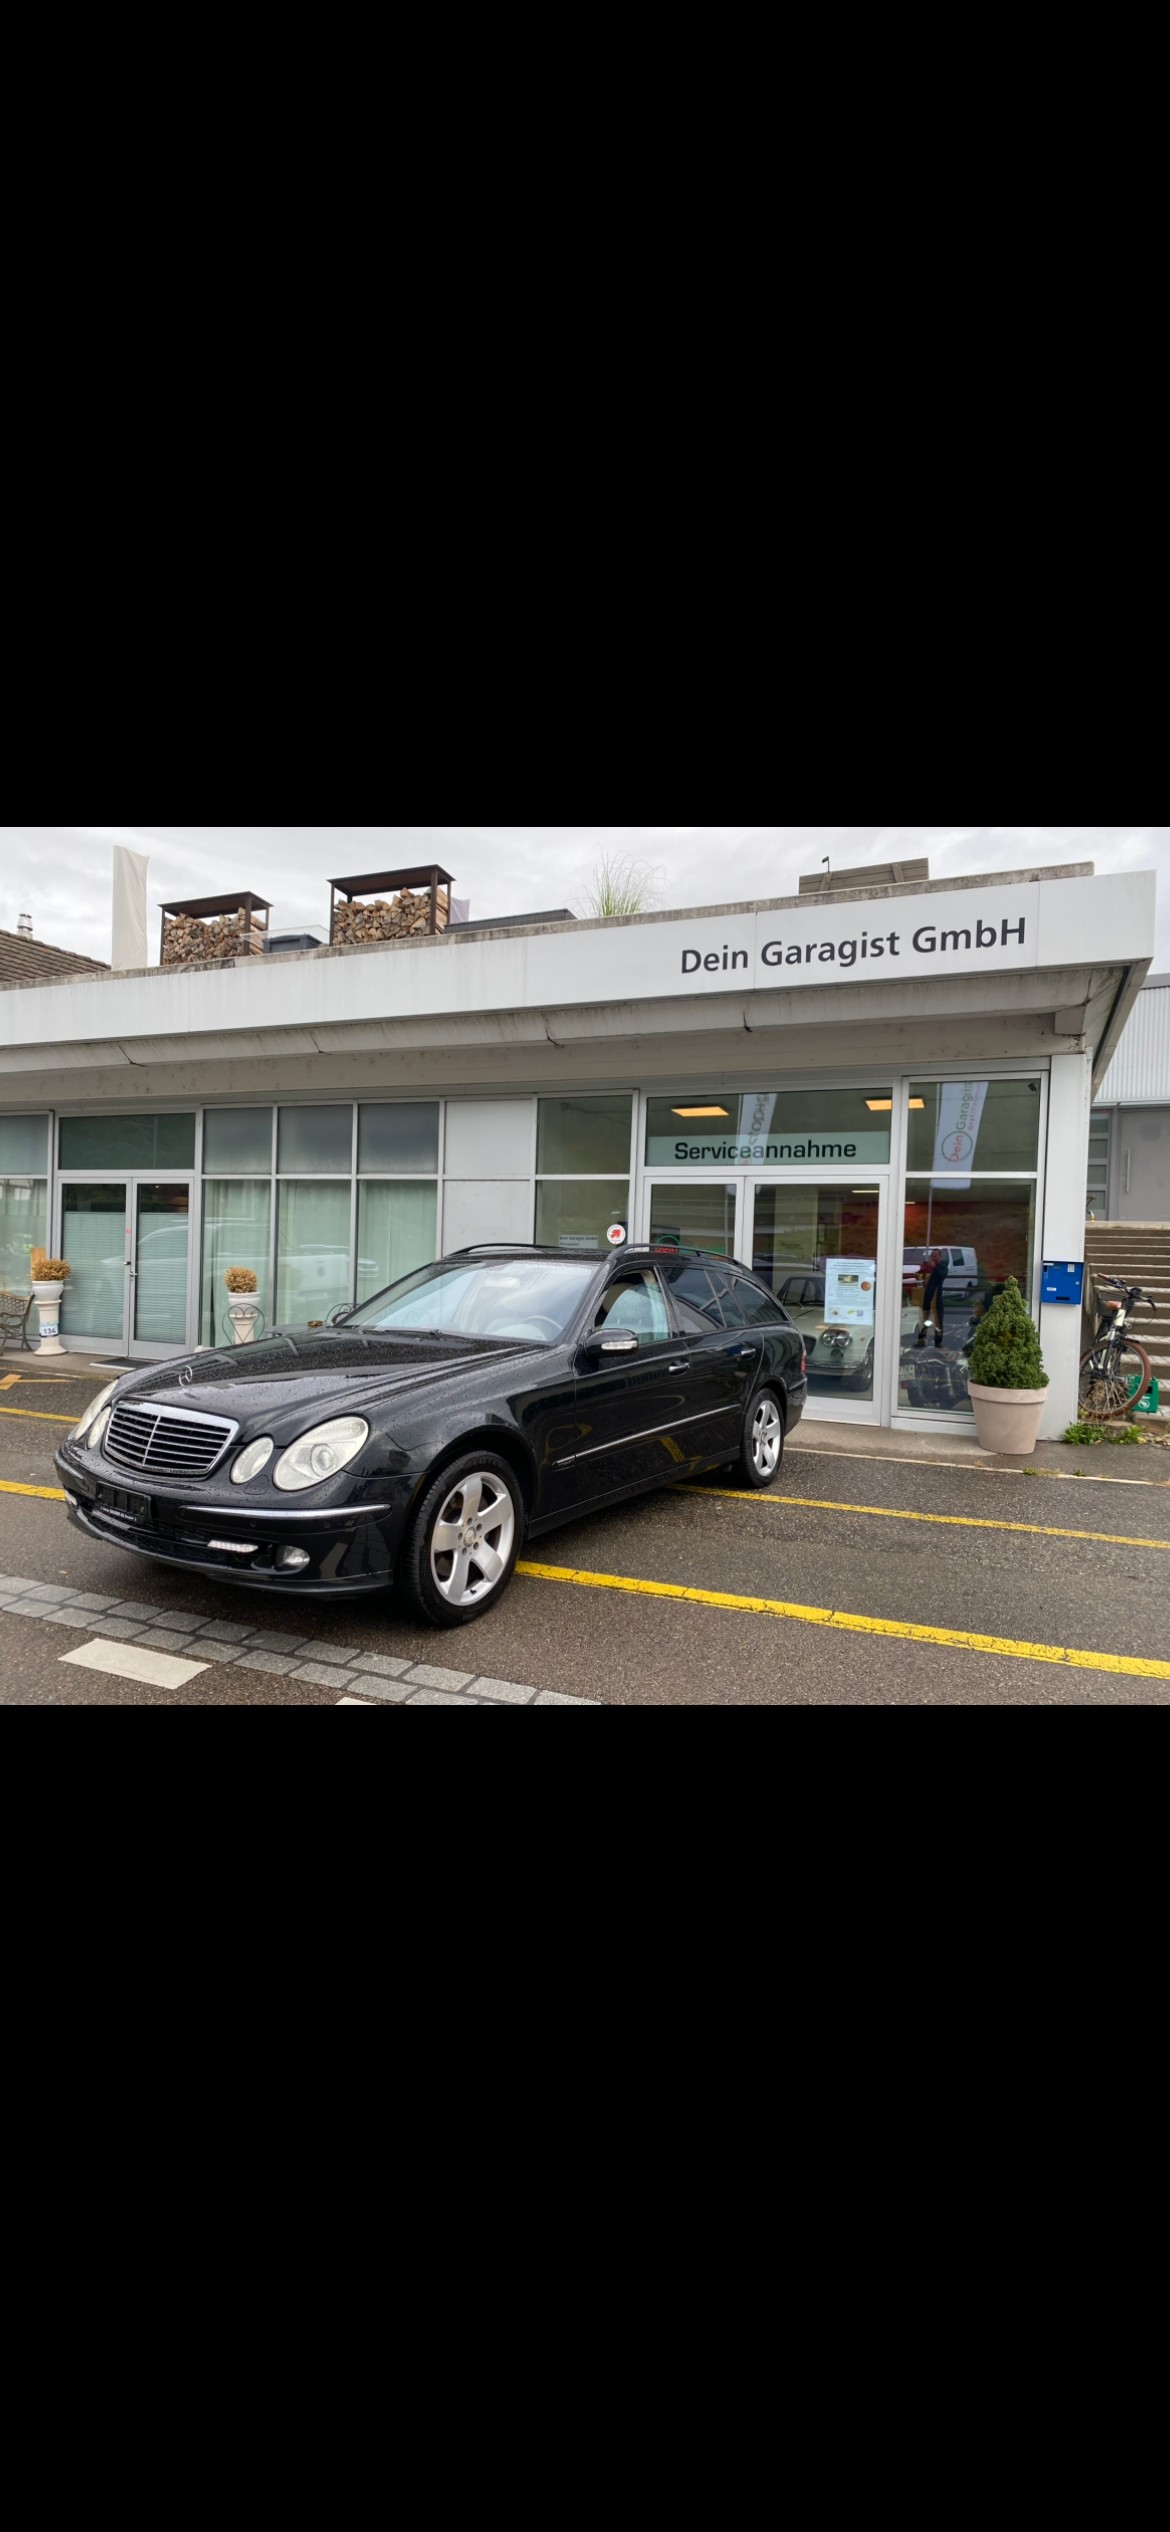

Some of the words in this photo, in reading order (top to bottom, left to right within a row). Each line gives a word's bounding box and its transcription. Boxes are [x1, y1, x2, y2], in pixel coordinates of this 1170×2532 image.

[681, 944, 749, 974] Dein
[761, 931, 900, 968] Garagist
[912, 917, 1026, 954] GmbH
[674, 1139, 857, 1160] Serviceannahme
[947, 1134, 964, 1163] Dein
